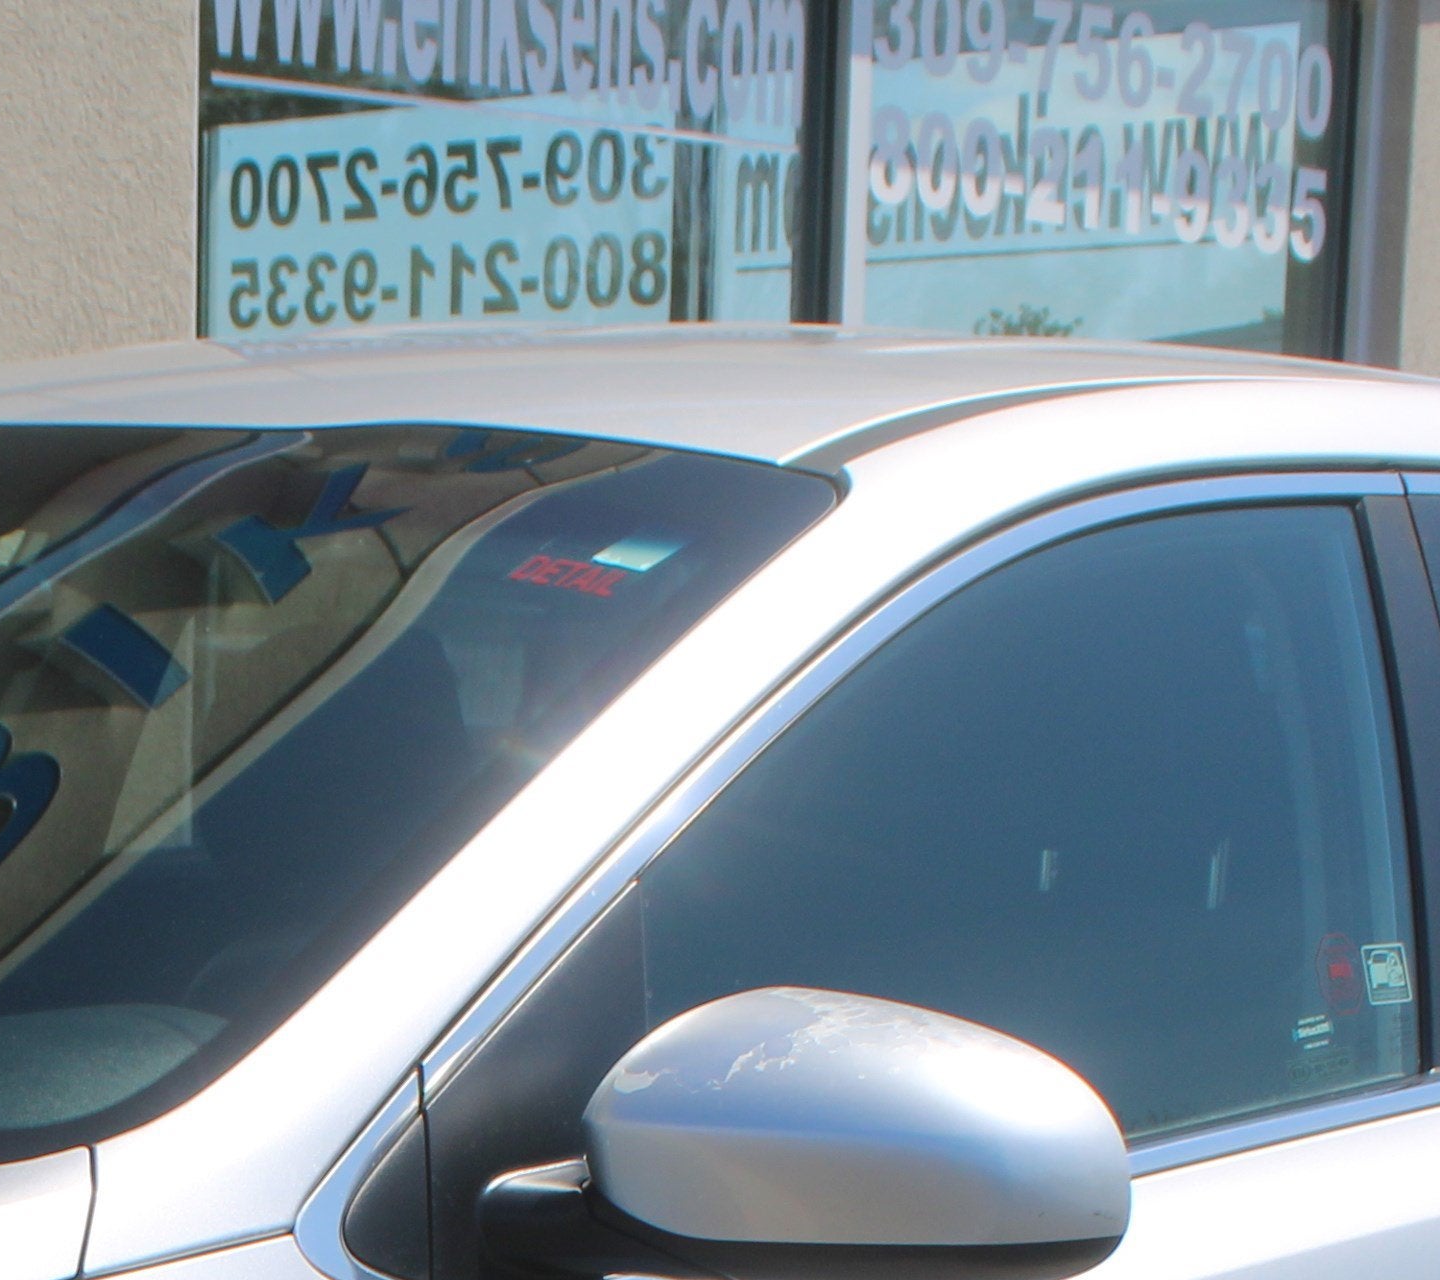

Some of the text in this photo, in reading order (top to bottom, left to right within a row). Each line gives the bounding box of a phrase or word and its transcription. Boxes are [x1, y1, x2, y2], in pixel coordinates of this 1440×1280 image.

[872, 0, 1333, 139] 309-756-2700
[868, 104, 1328, 262] 800-211-9335
[507, 554, 627, 597] DETAIL
